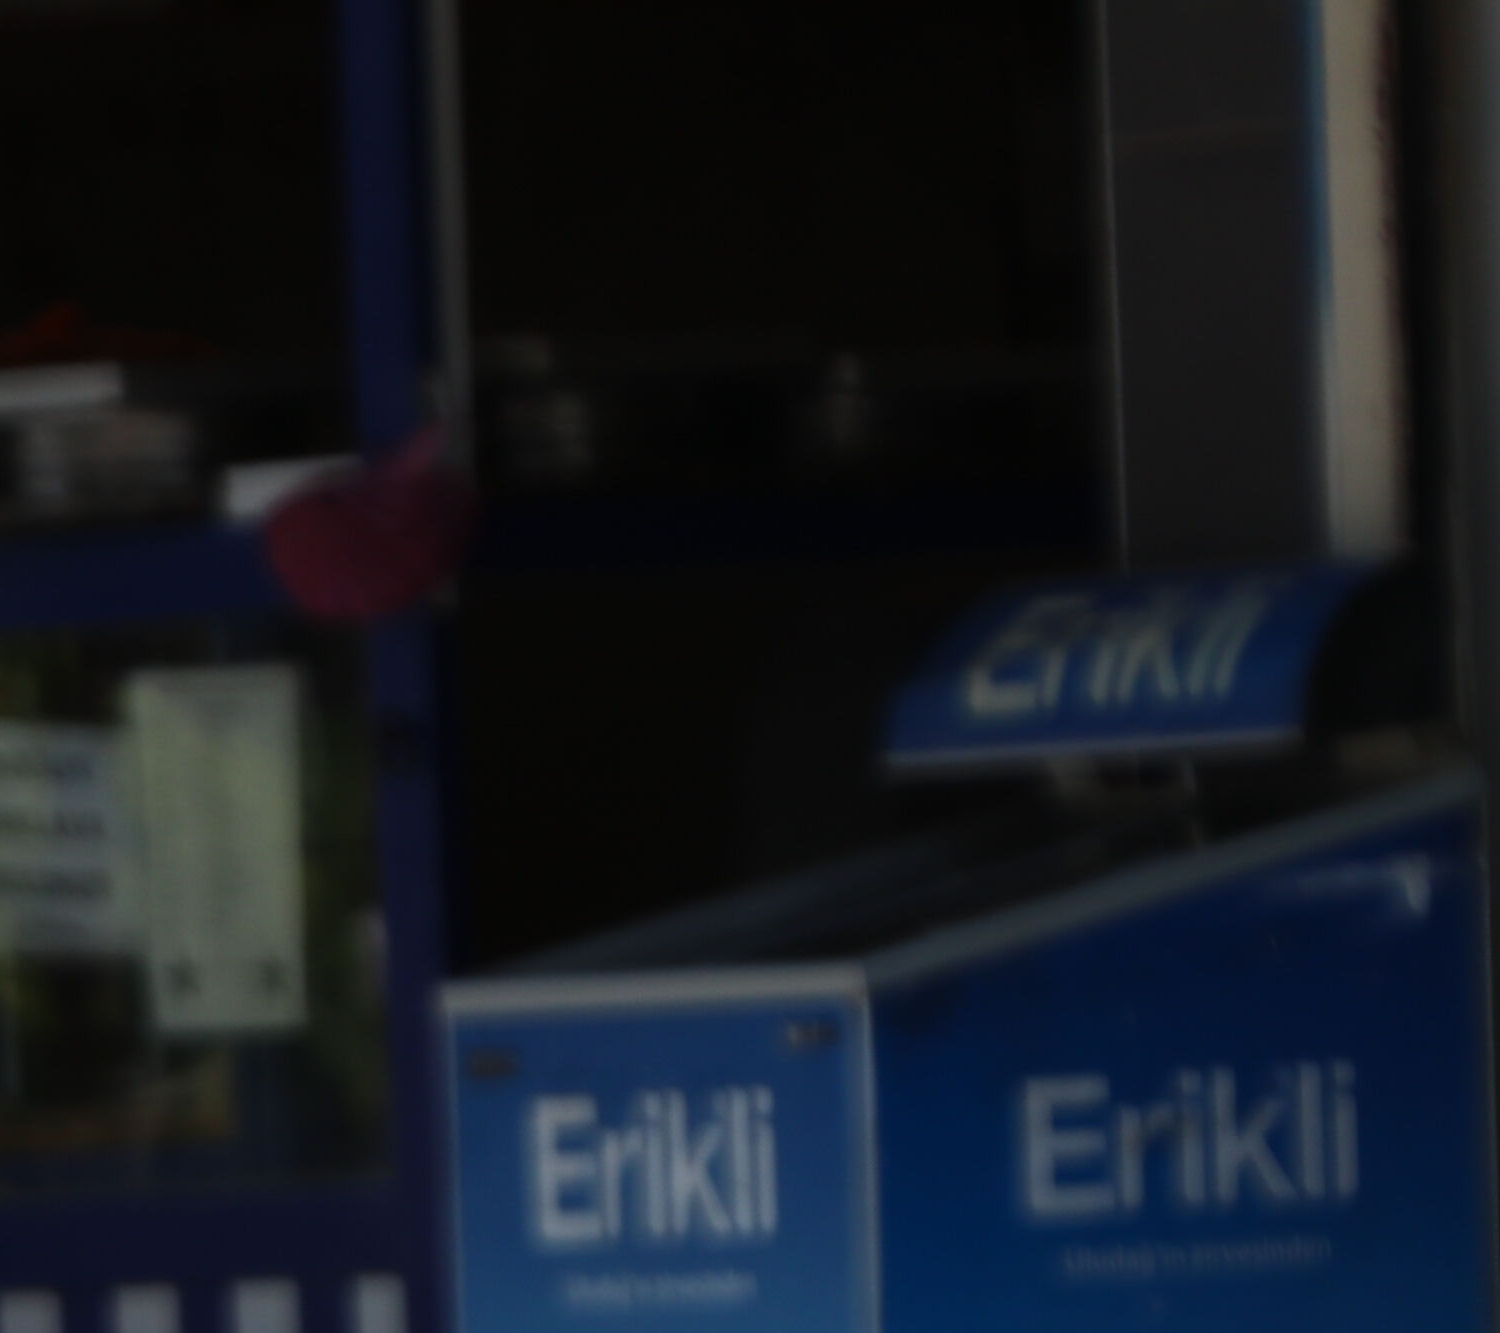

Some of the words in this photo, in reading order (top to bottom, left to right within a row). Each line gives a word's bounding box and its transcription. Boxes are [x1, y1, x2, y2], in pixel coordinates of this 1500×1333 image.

[964, 572, 1278, 712] Erikli
[525, 1083, 782, 1246] Erikli
[1012, 1057, 1362, 1224] Erikli
